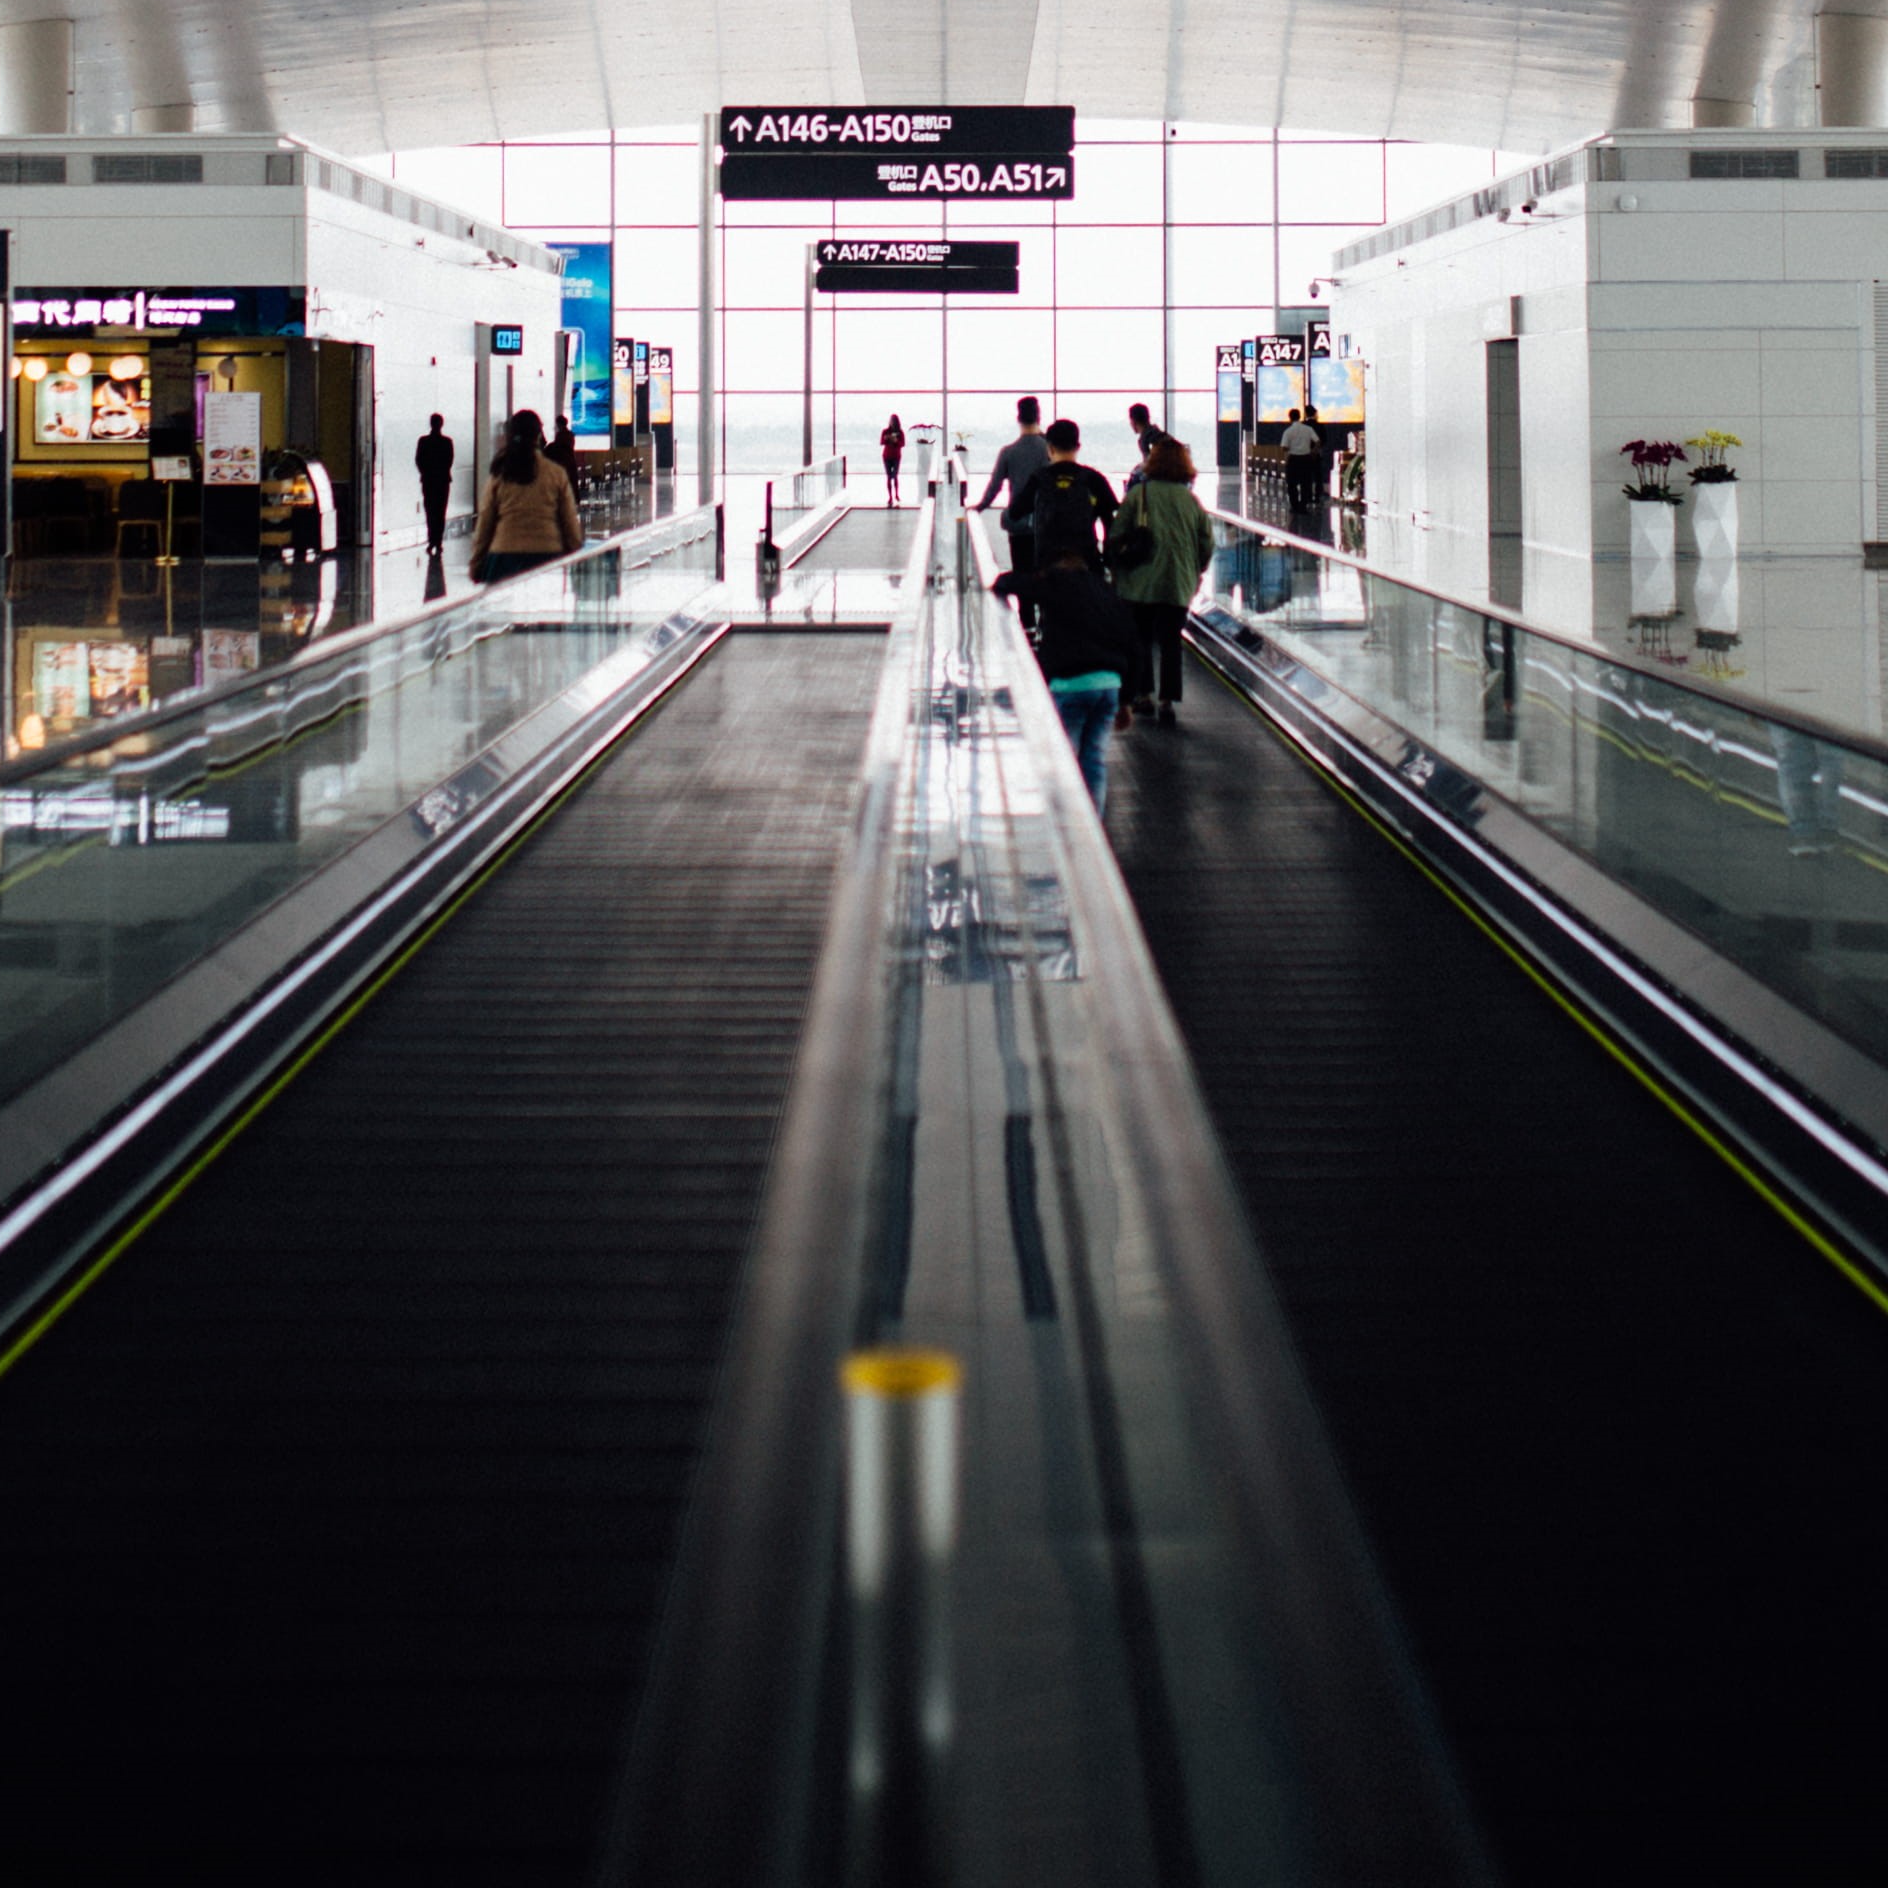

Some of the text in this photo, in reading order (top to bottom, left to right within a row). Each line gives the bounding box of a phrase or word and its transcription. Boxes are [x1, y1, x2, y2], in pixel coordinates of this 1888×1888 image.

[755, 115, 911, 142] A146-A150
[912, 116, 952, 130] 登机口
[912, 131, 940, 142] Gates
[878, 166, 918, 180] 登机口
[888, 181, 917, 192] Gates
[838, 244, 926, 261] A147-A150
[1261, 344, 1302, 360] A147
